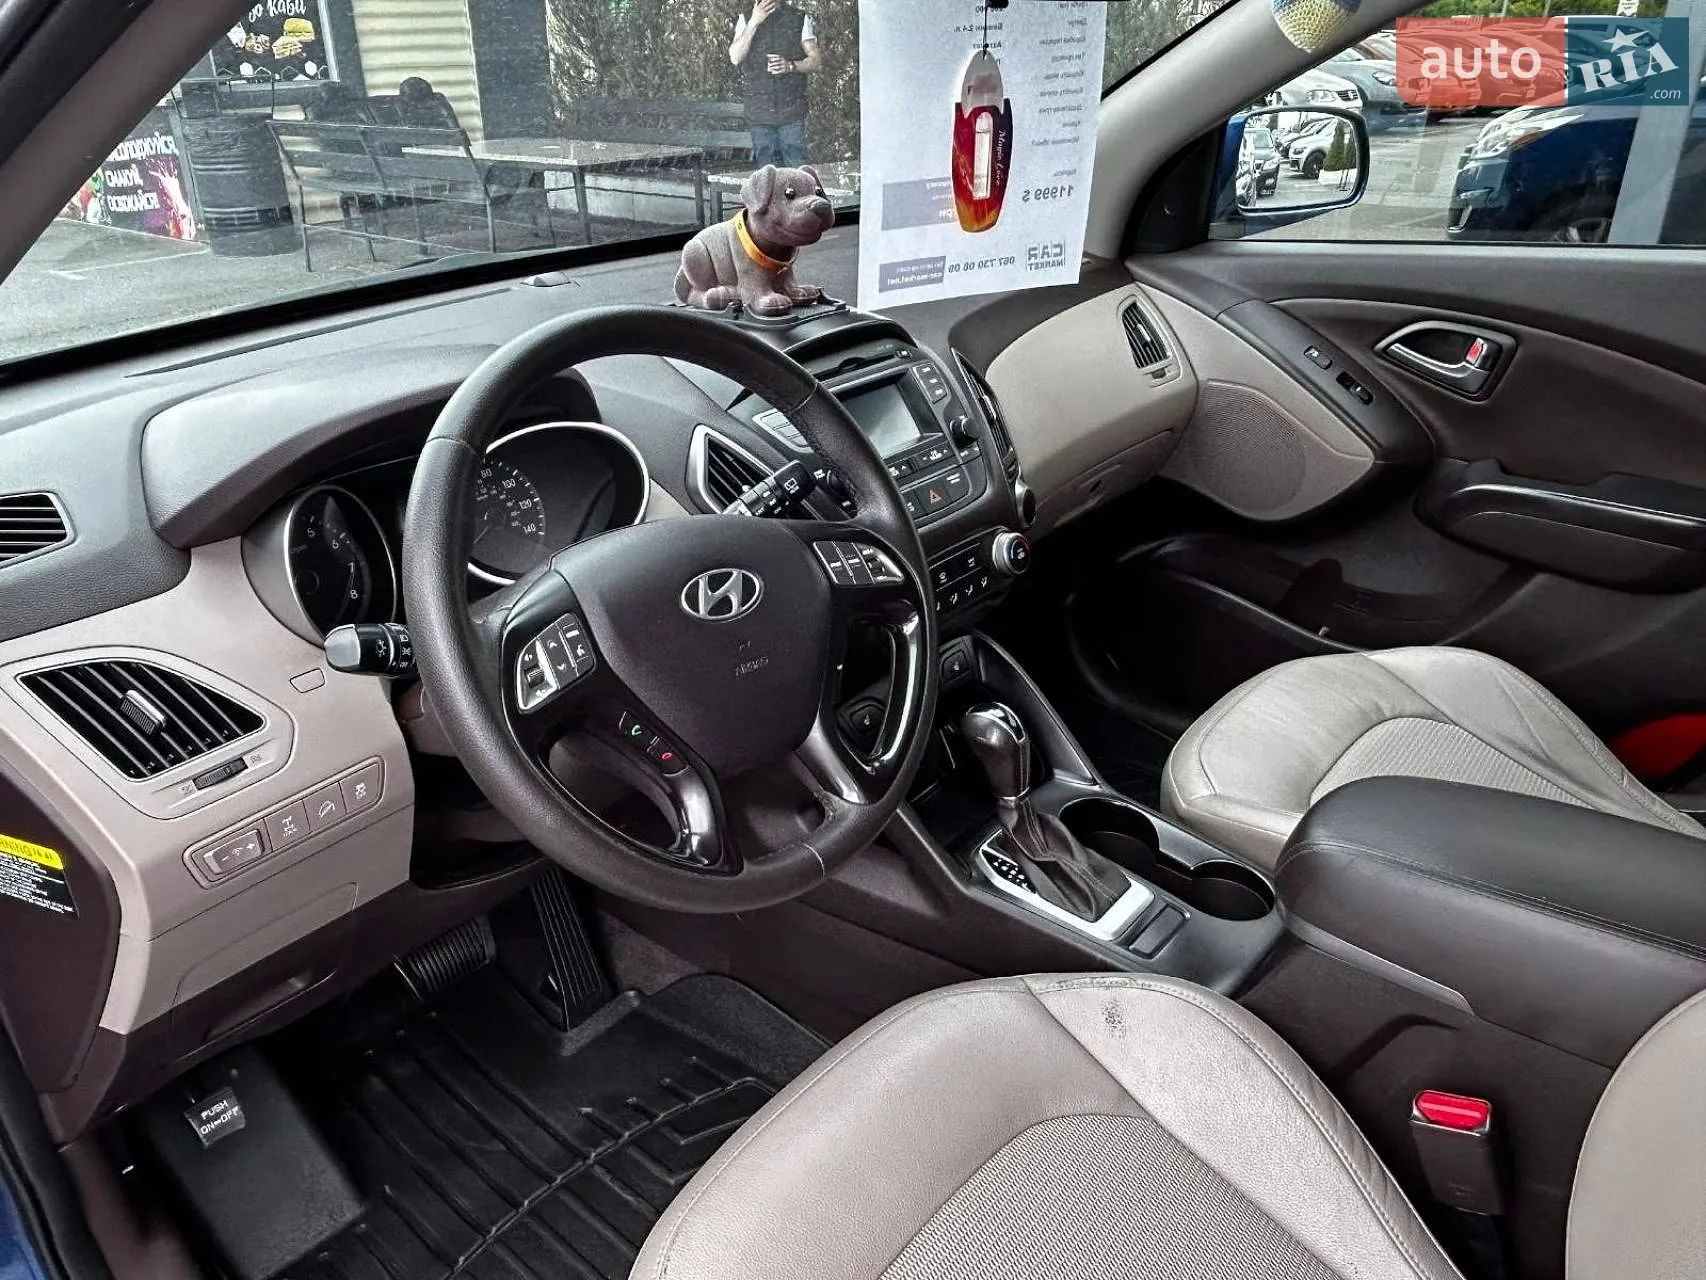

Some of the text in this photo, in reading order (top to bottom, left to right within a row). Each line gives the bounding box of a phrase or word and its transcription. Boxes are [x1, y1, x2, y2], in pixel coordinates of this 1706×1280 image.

[522, 523, 536, 534] 140
[332, 539, 340, 550] 6
[350, 589, 359, 600] 8
[201, 1100, 229, 1120] PUSH
